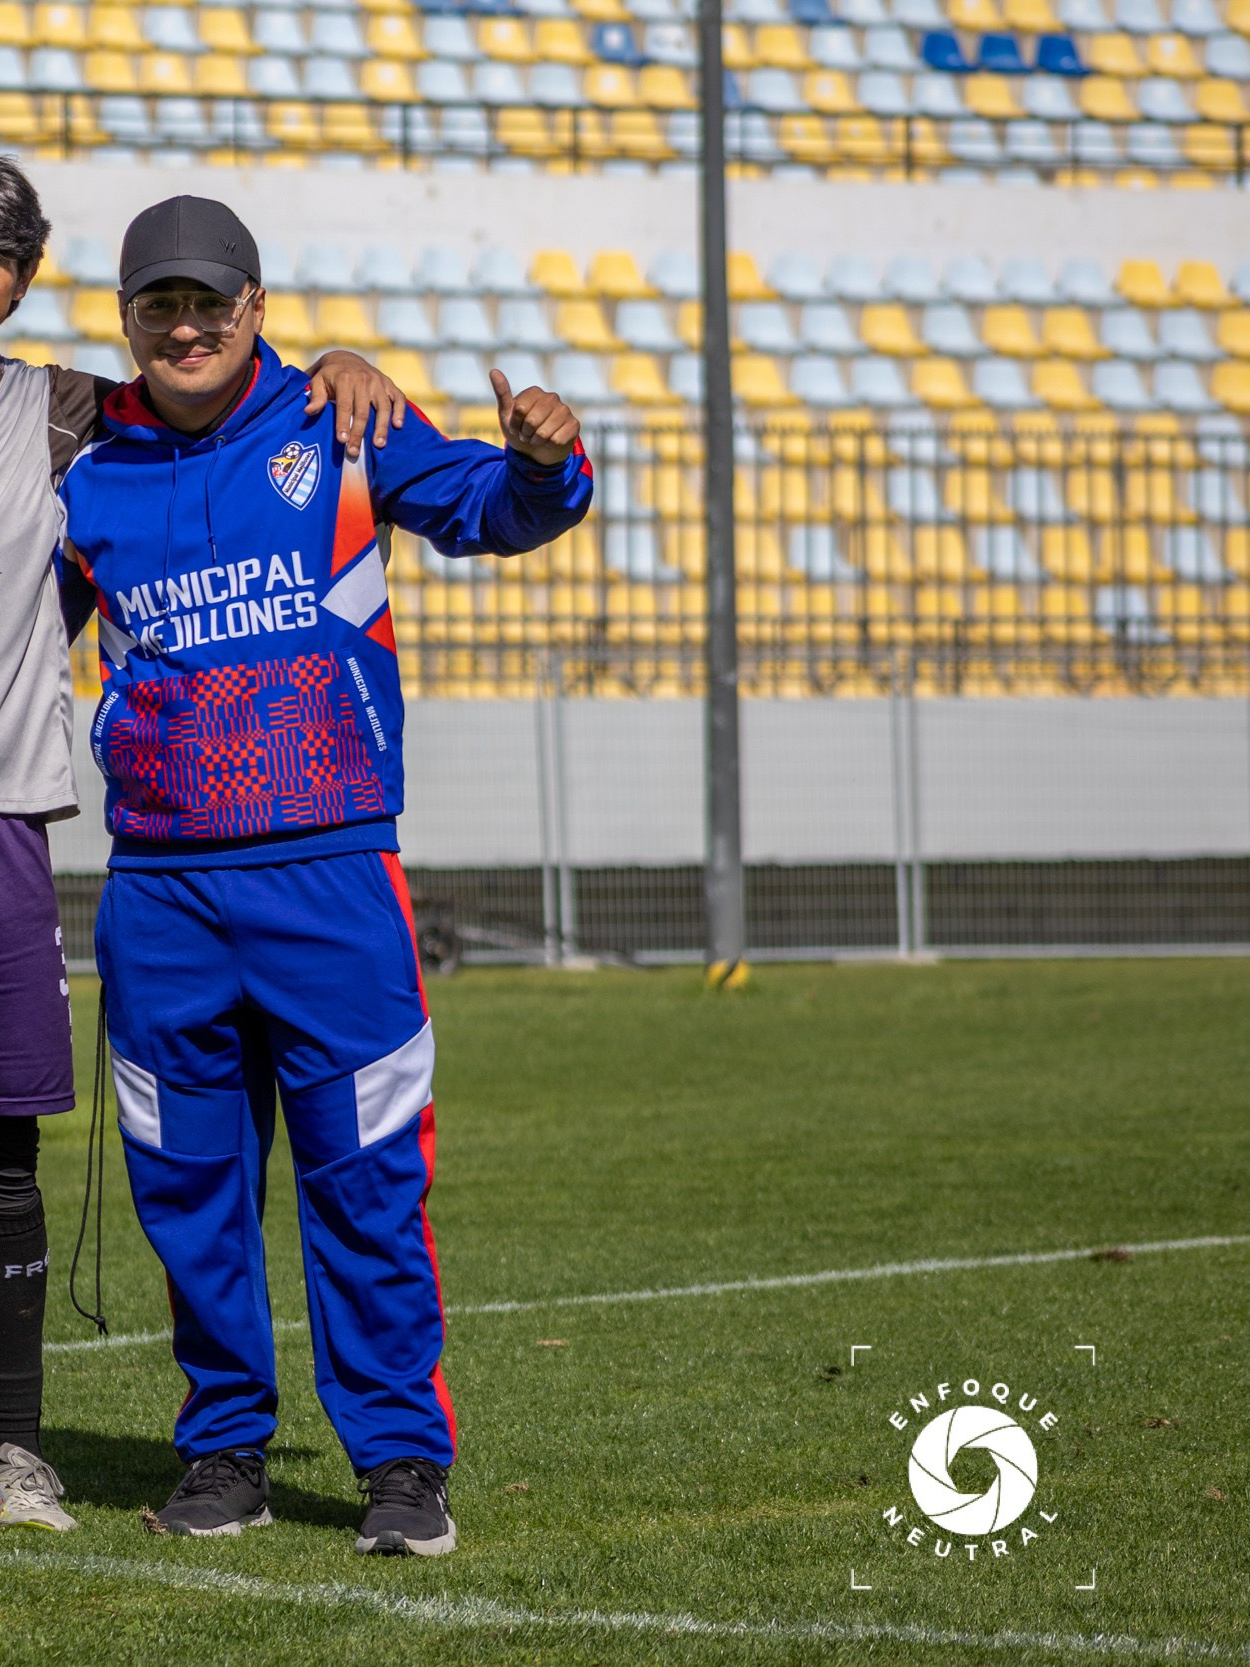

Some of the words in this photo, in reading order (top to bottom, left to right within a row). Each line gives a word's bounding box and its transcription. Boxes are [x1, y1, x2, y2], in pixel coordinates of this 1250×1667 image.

[116, 551, 315, 625] MUNICIPAL
[130, 591, 318, 659] MEJILLONES
[94, 691, 119, 738] MEJILLONES
[346, 657, 370, 703] MUNICIPAL
[366, 705, 387, 752] MEJILLONES
